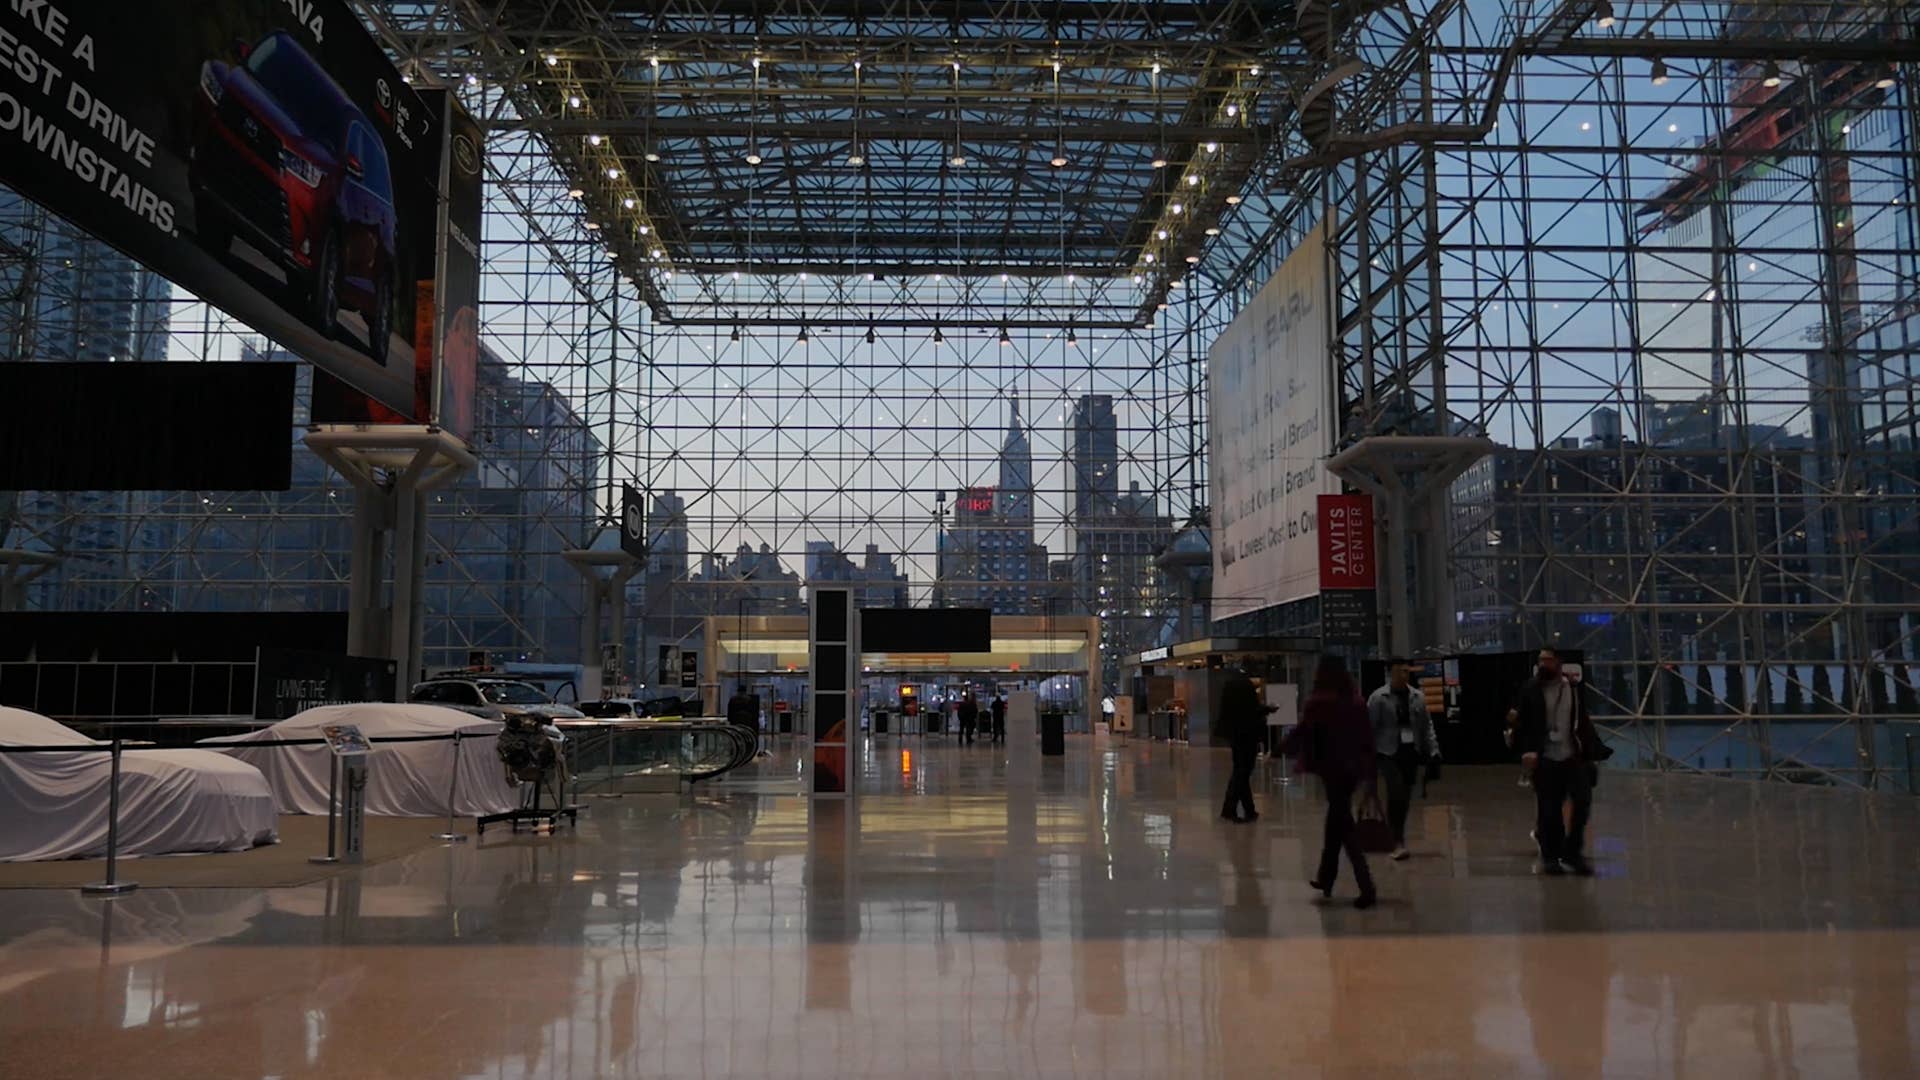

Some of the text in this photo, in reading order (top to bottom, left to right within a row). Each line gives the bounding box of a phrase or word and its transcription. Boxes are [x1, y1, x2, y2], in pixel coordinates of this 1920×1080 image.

[71, 33, 96, 72] A
[65, 80, 156, 168] DRIVE
[1286, 457, 1315, 495] Brand
[1288, 518, 1298, 540] to
[1329, 507, 1348, 576] JAVITS
[1351, 506, 1365, 576] CENTER
[308, 680, 327, 698] THE
